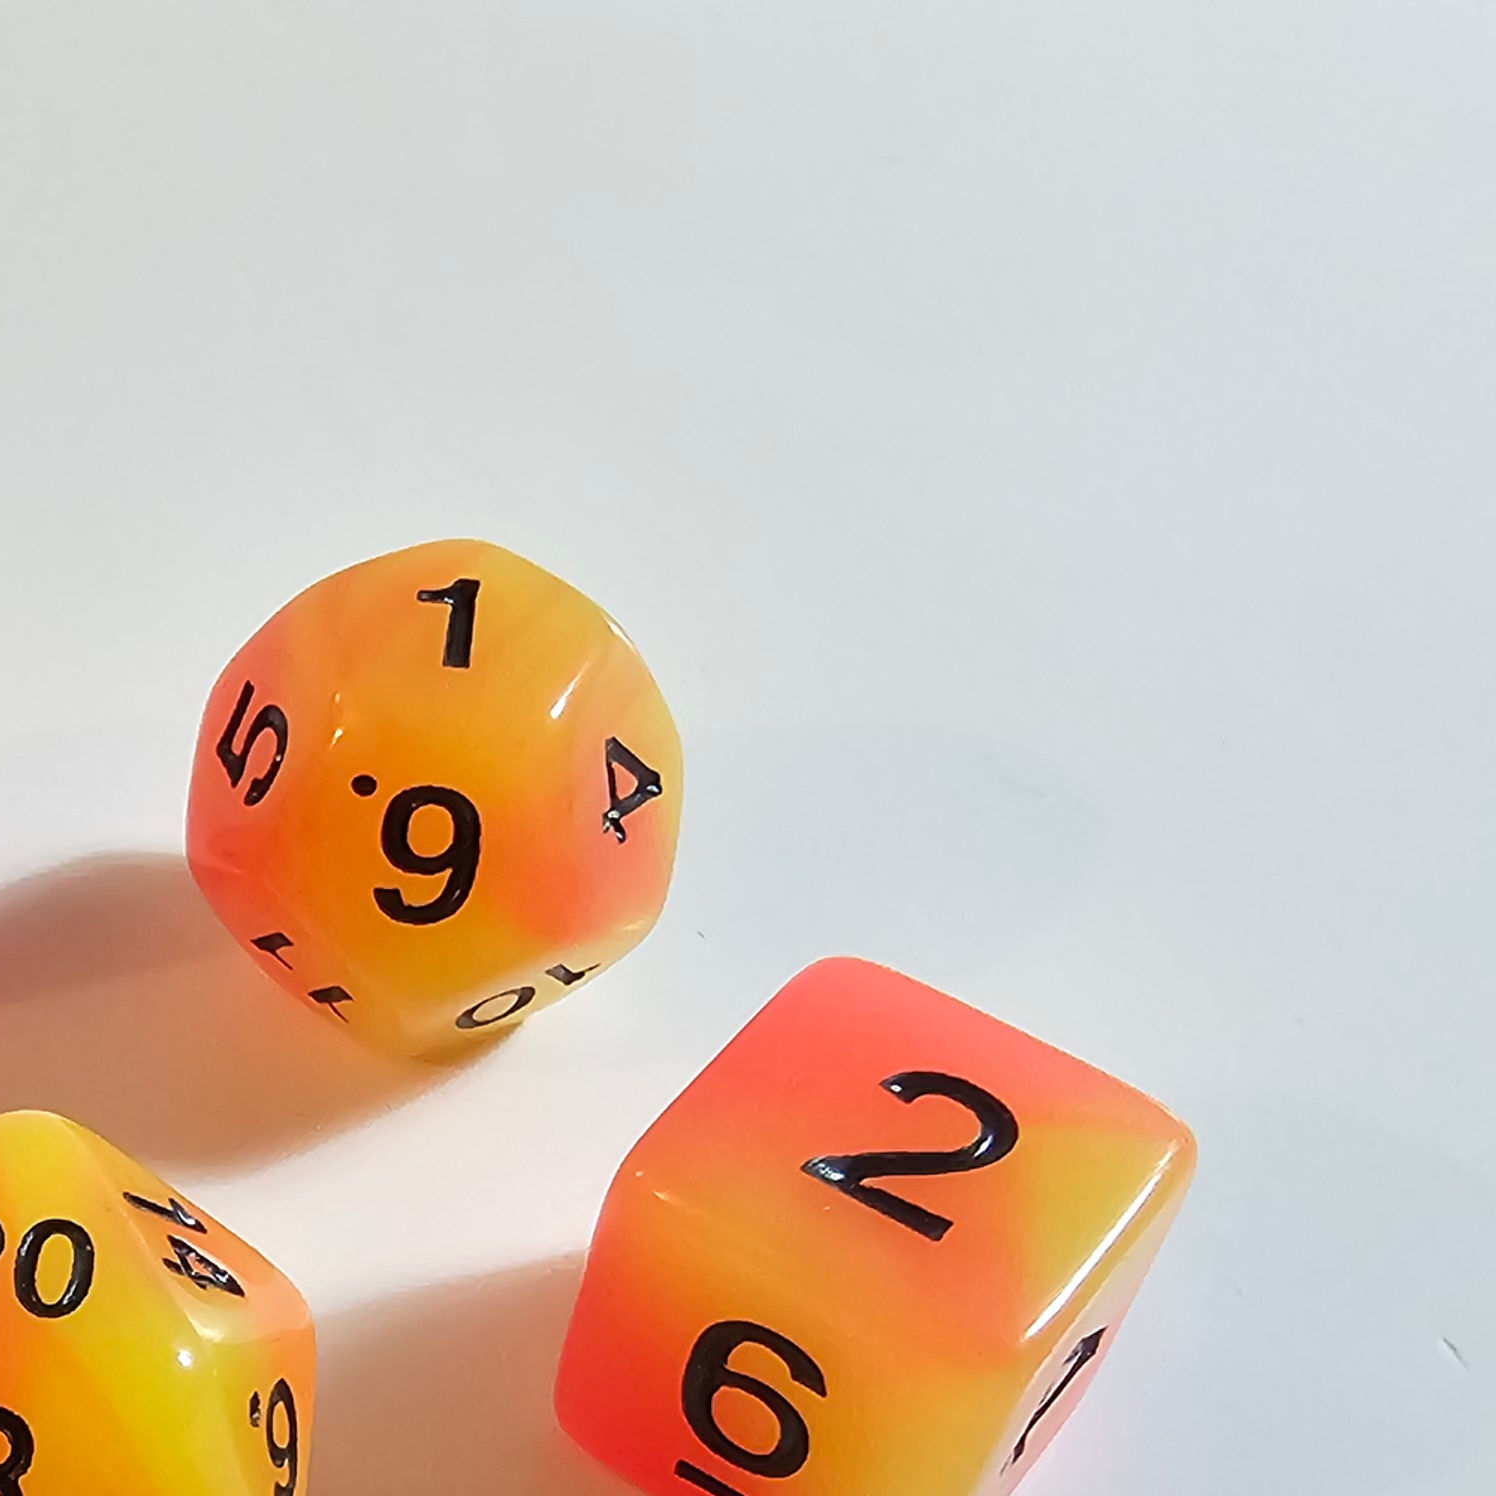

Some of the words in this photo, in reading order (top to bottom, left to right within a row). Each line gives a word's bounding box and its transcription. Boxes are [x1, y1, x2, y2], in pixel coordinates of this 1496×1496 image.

[415, 577, 481, 669] 1
[215, 680, 289, 807] 5
[601, 736, 664, 845] 4
[455, 962, 601, 1030] 10
[800, 1070, 1020, 1243] 2
[121, 1190, 246, 1298] 14
